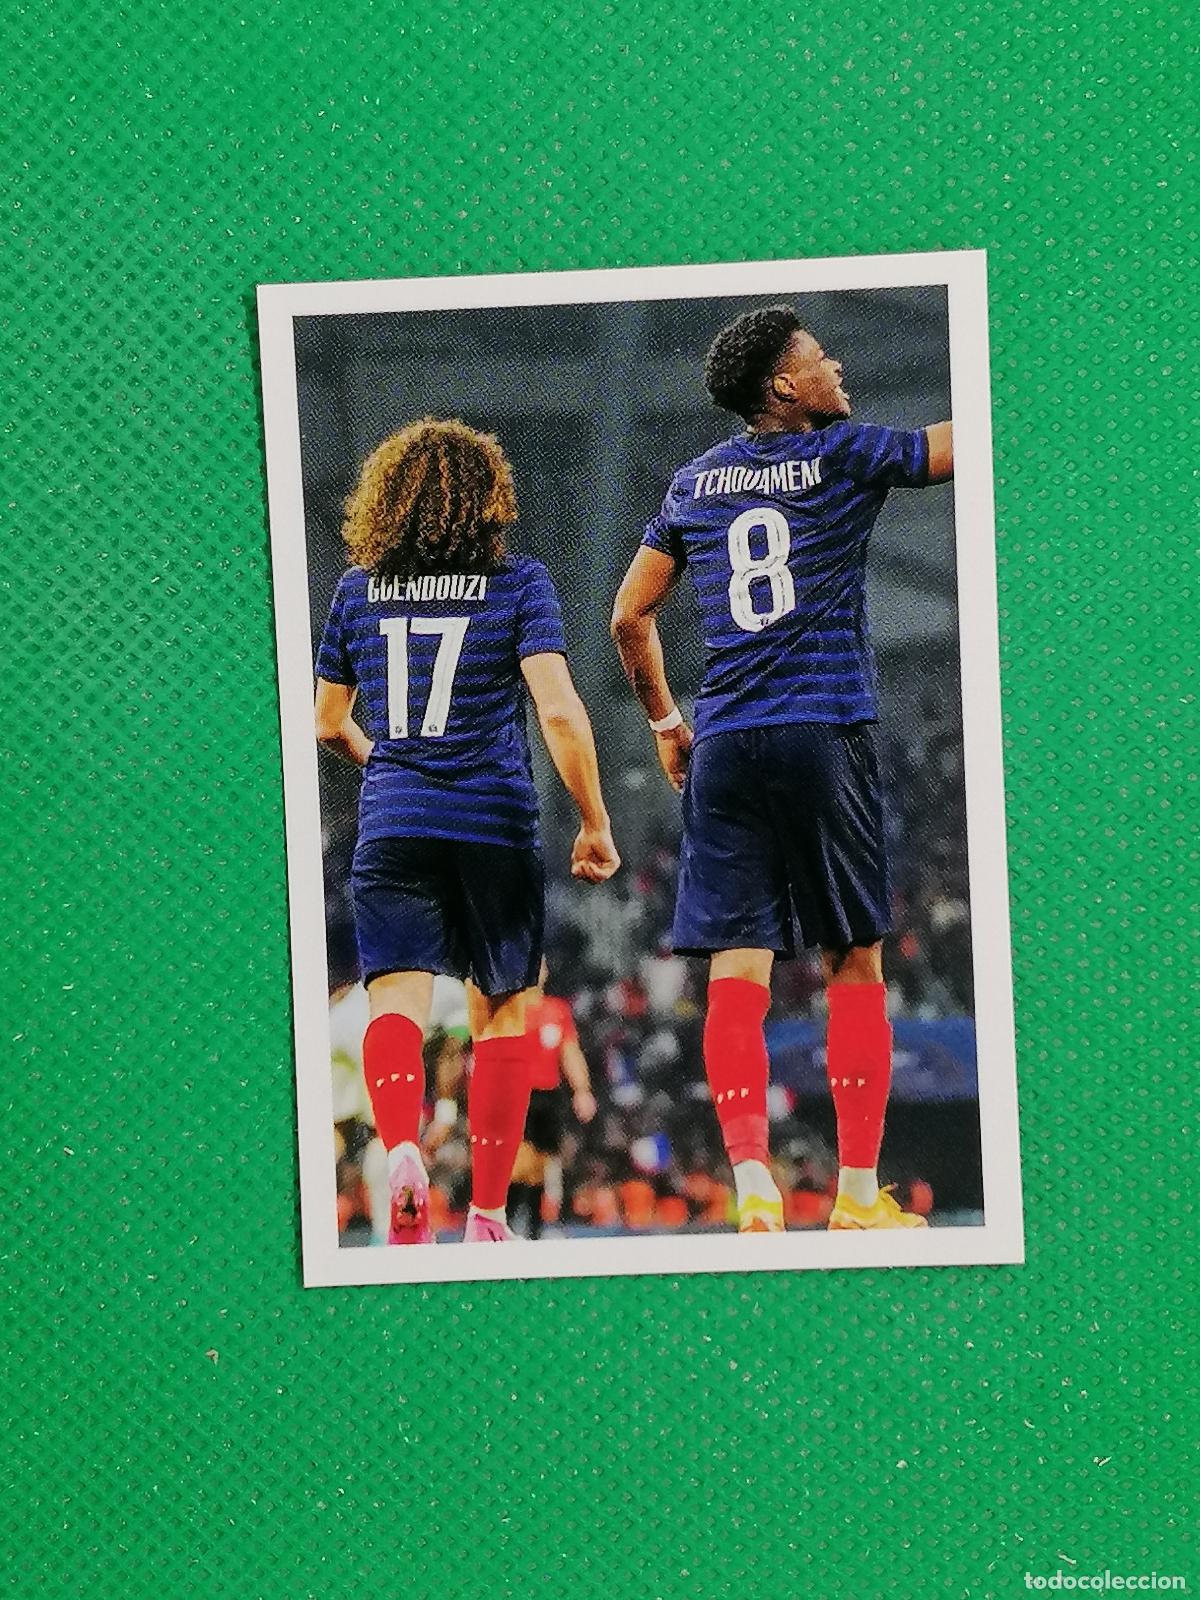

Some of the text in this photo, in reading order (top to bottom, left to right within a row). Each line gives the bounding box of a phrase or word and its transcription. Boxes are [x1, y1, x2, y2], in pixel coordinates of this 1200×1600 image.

[693, 457, 822, 499] TCHOUAMENI
[727, 507, 796, 632] 8
[379, 617, 470, 739] 17
